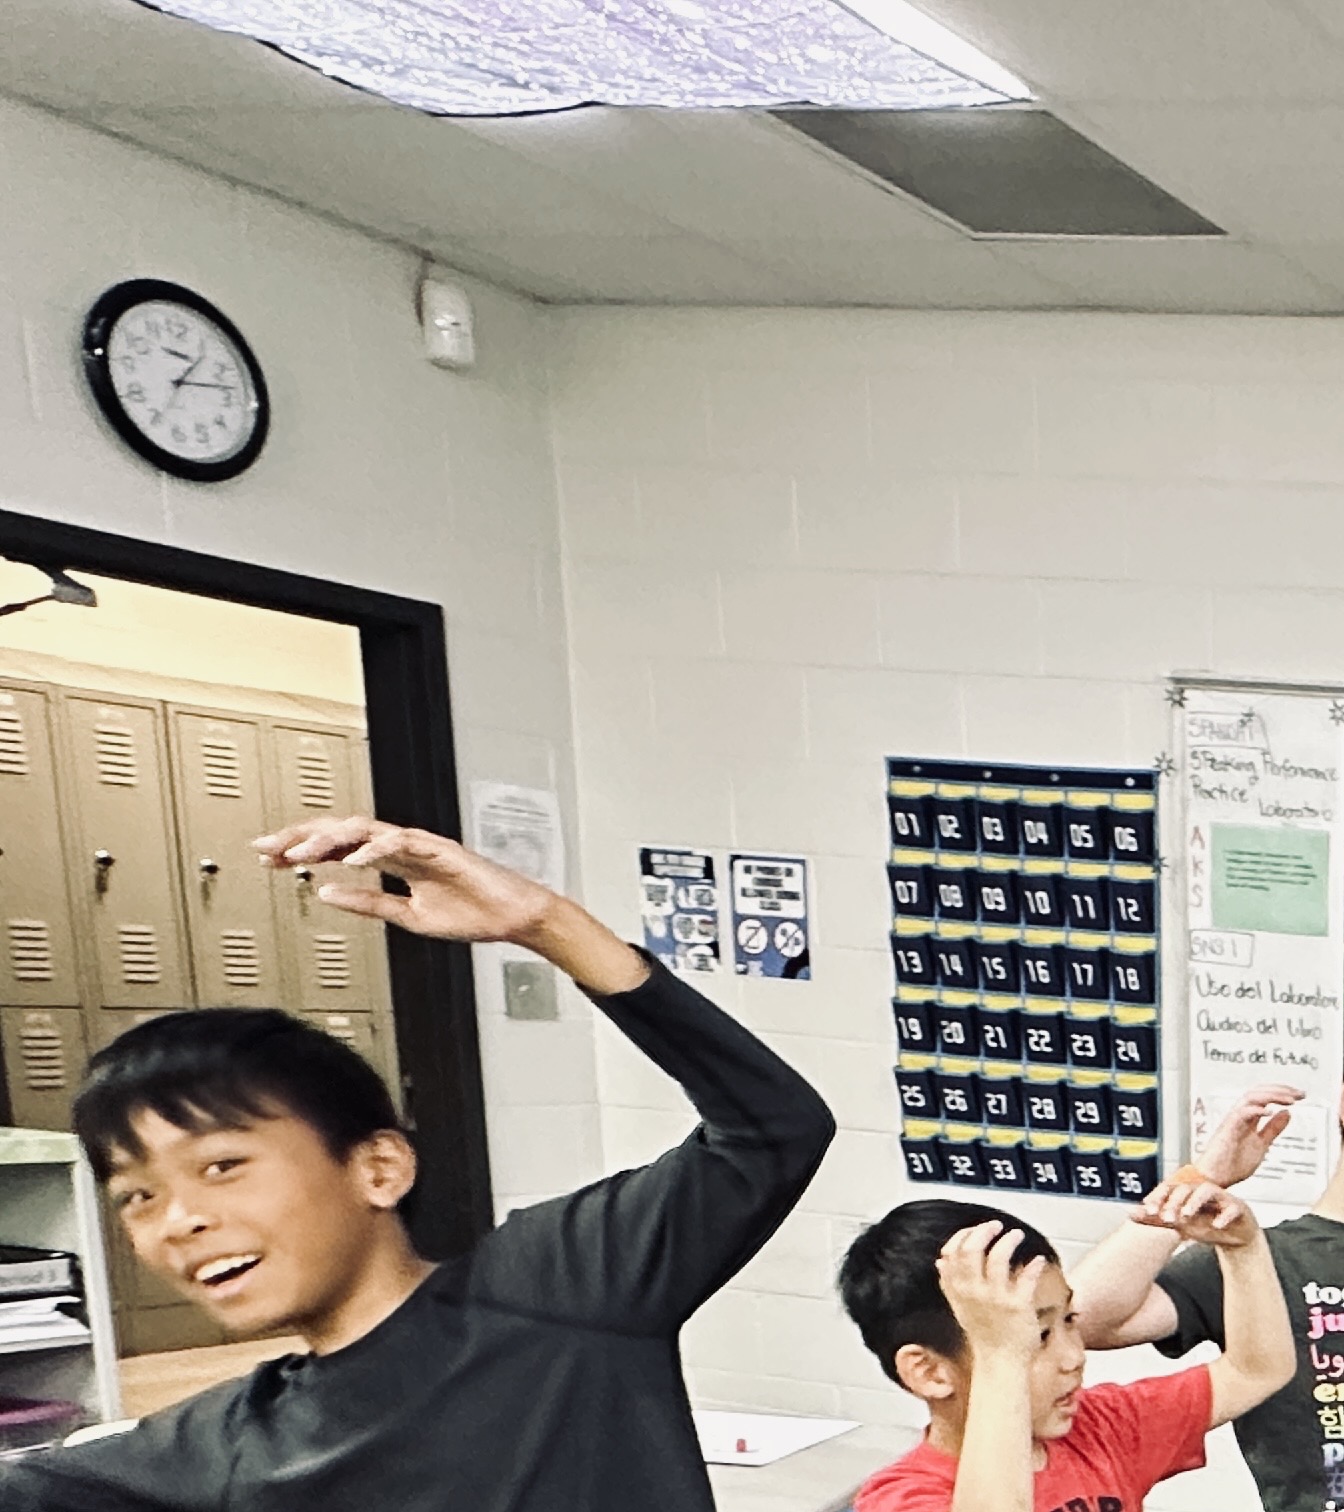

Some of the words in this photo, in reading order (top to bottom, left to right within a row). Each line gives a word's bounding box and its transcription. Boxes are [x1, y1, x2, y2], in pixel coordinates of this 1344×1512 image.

[894, 812, 920, 836] 01
[937, 814, 962, 839] 02
[982, 816, 1005, 842] 03
[1024, 820, 1049, 845] 04
[1069, 823, 1094, 848] 05
[1114, 826, 1138, 852] 06
[894, 880, 918, 904] 07
[938, 884, 964, 908] 08
[981, 886, 1007, 912] 09
[1024, 890, 1052, 915] 10
[1071, 894, 1096, 919] 11
[1116, 897, 1141, 922] 12
[896, 950, 923, 974] 13
[938, 953, 964, 976] 14
[982, 956, 1007, 980] 15
[1025, 959, 1051, 984] 16
[1072, 962, 1094, 986] 17
[1115, 966, 1140, 991] 18
[898, 1016, 923, 1041] 19
[940, 1020, 966, 1044] 20
[983, 1024, 1008, 1049] 21
[1026, 1028, 1054, 1053] 22
[1070, 1033, 1097, 1058] 23
[1115, 1038, 1140, 1062] 24
[900, 1084, 926, 1108] 25
[942, 1088, 968, 1112] 26
[984, 1092, 1008, 1115] 27
[1029, 1097, 1057, 1120] 28
[1074, 1100, 1100, 1124] 29
[1118, 1104, 1144, 1128] 30
[908, 1152, 934, 1174] 31
[948, 1154, 976, 1176] 32
[989, 1158, 1017, 1180] 33
[1032, 1162, 1058, 1184] 34
[1076, 1165, 1102, 1188] 35
[1116, 1171, 1143, 1197] 36
